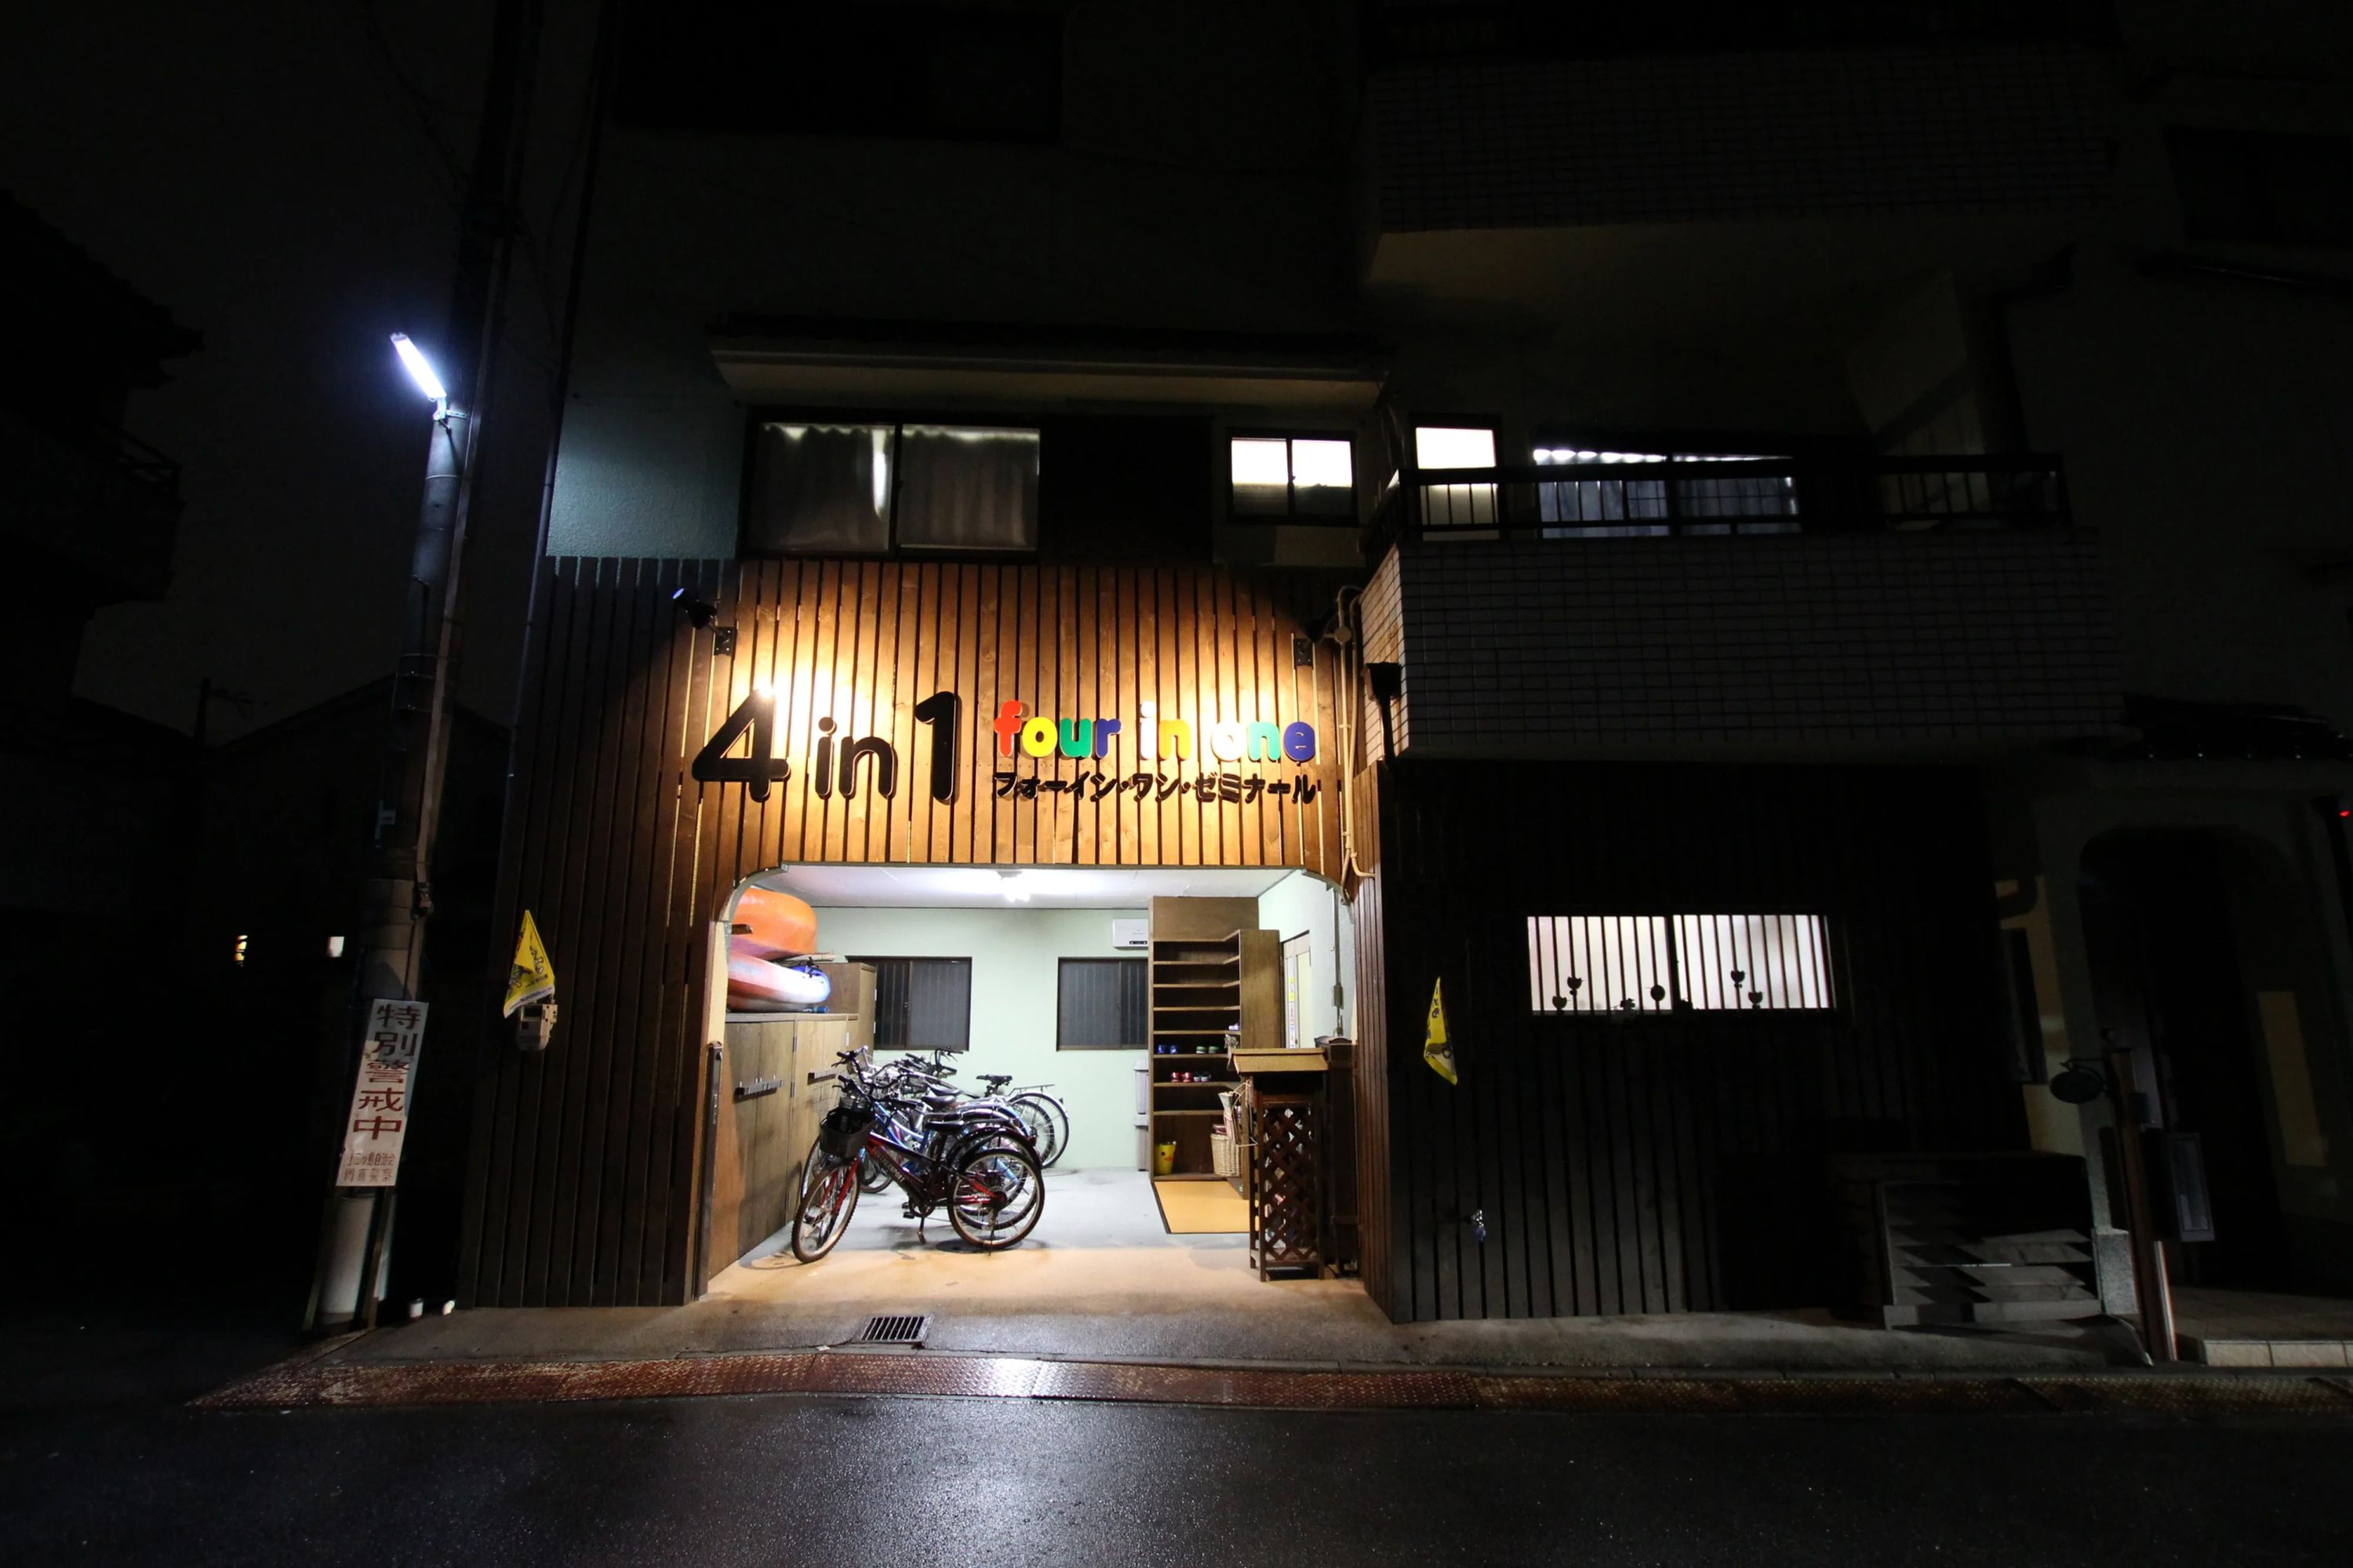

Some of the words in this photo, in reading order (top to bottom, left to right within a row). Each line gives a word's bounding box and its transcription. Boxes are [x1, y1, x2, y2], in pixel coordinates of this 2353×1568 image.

[692, 688, 790, 802] 4
[815, 717, 896, 799] in
[915, 691, 959, 803] 1
[994, 700, 1122, 759] four
[1140, 700, 1191, 760] in
[1210, 721, 1316, 763] one
[353, 1003, 421, 1140] 特別警戒中
